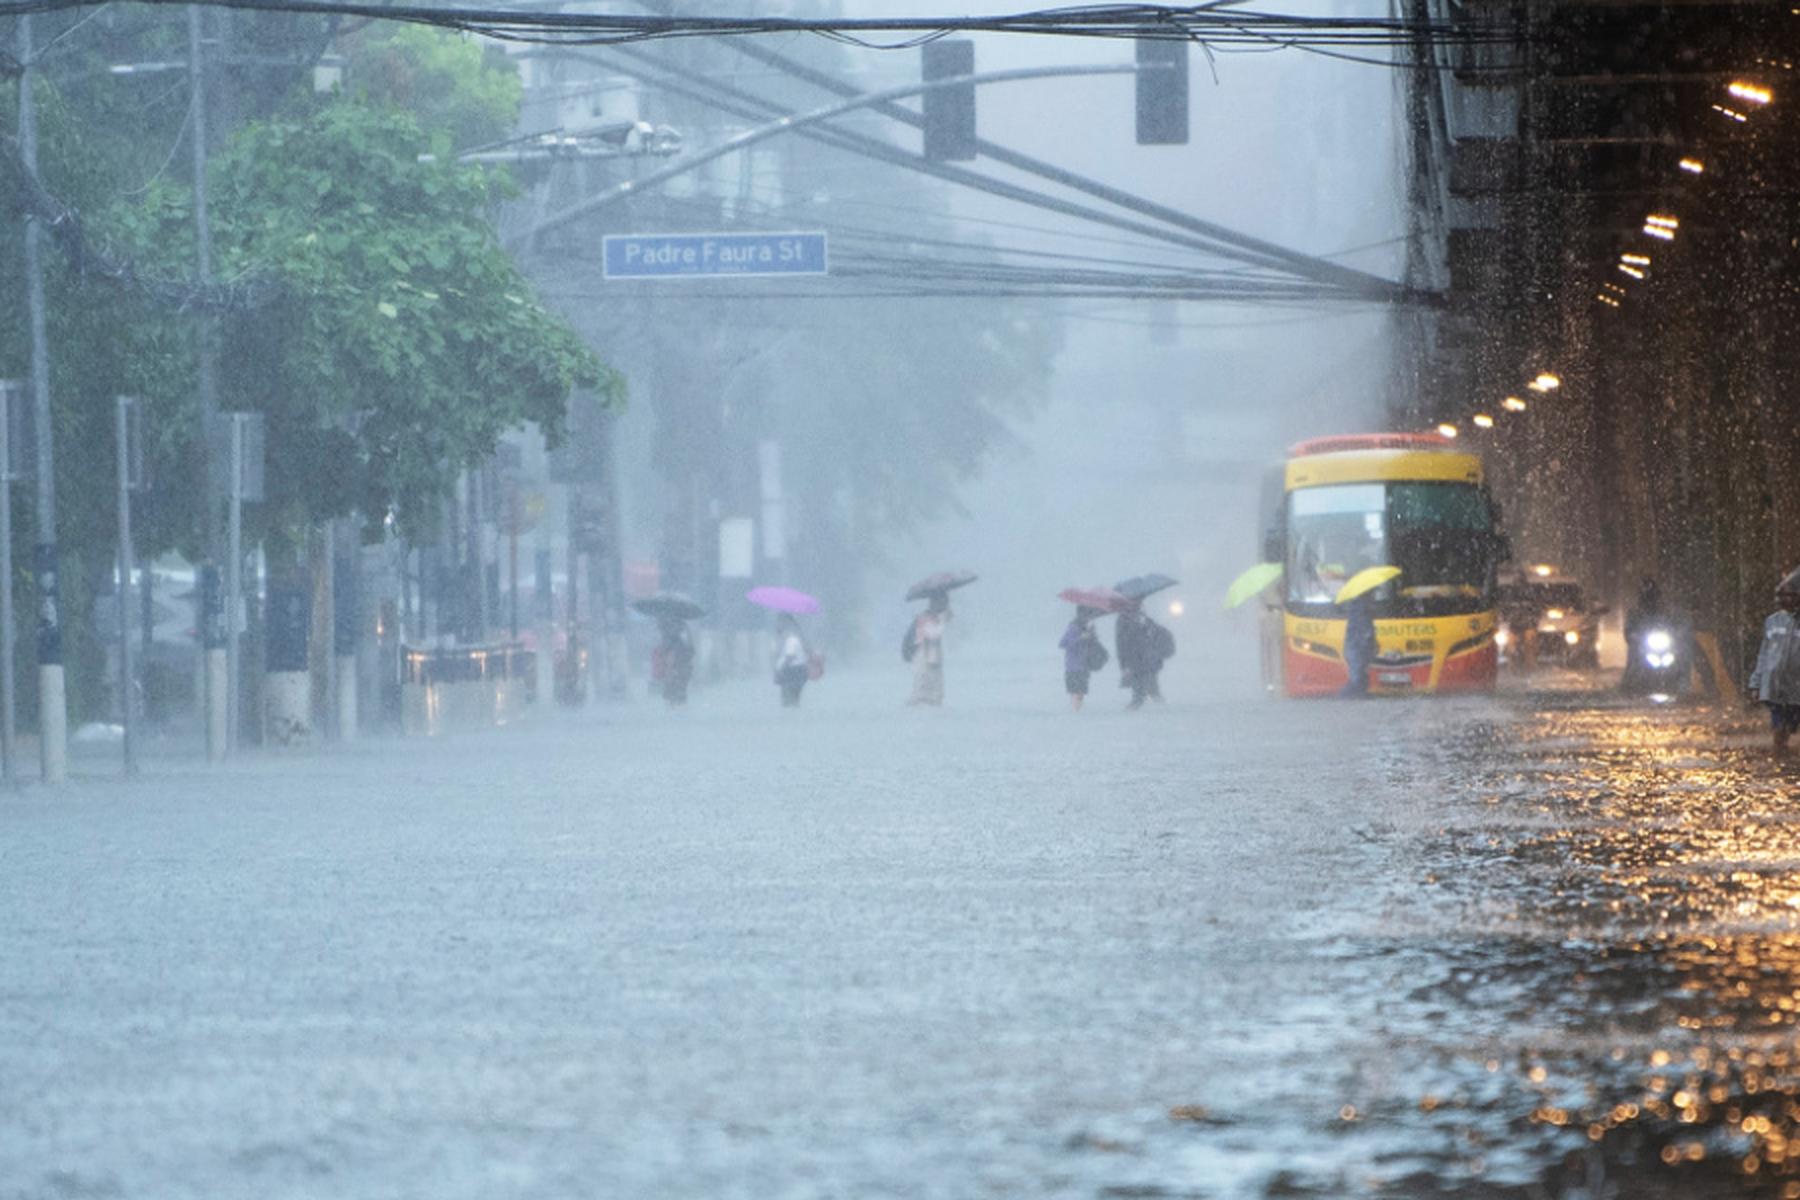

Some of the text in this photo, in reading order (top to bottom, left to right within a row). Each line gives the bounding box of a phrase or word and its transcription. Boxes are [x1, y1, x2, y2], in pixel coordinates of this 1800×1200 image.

[625, 239, 803, 264] Padre Faura St
